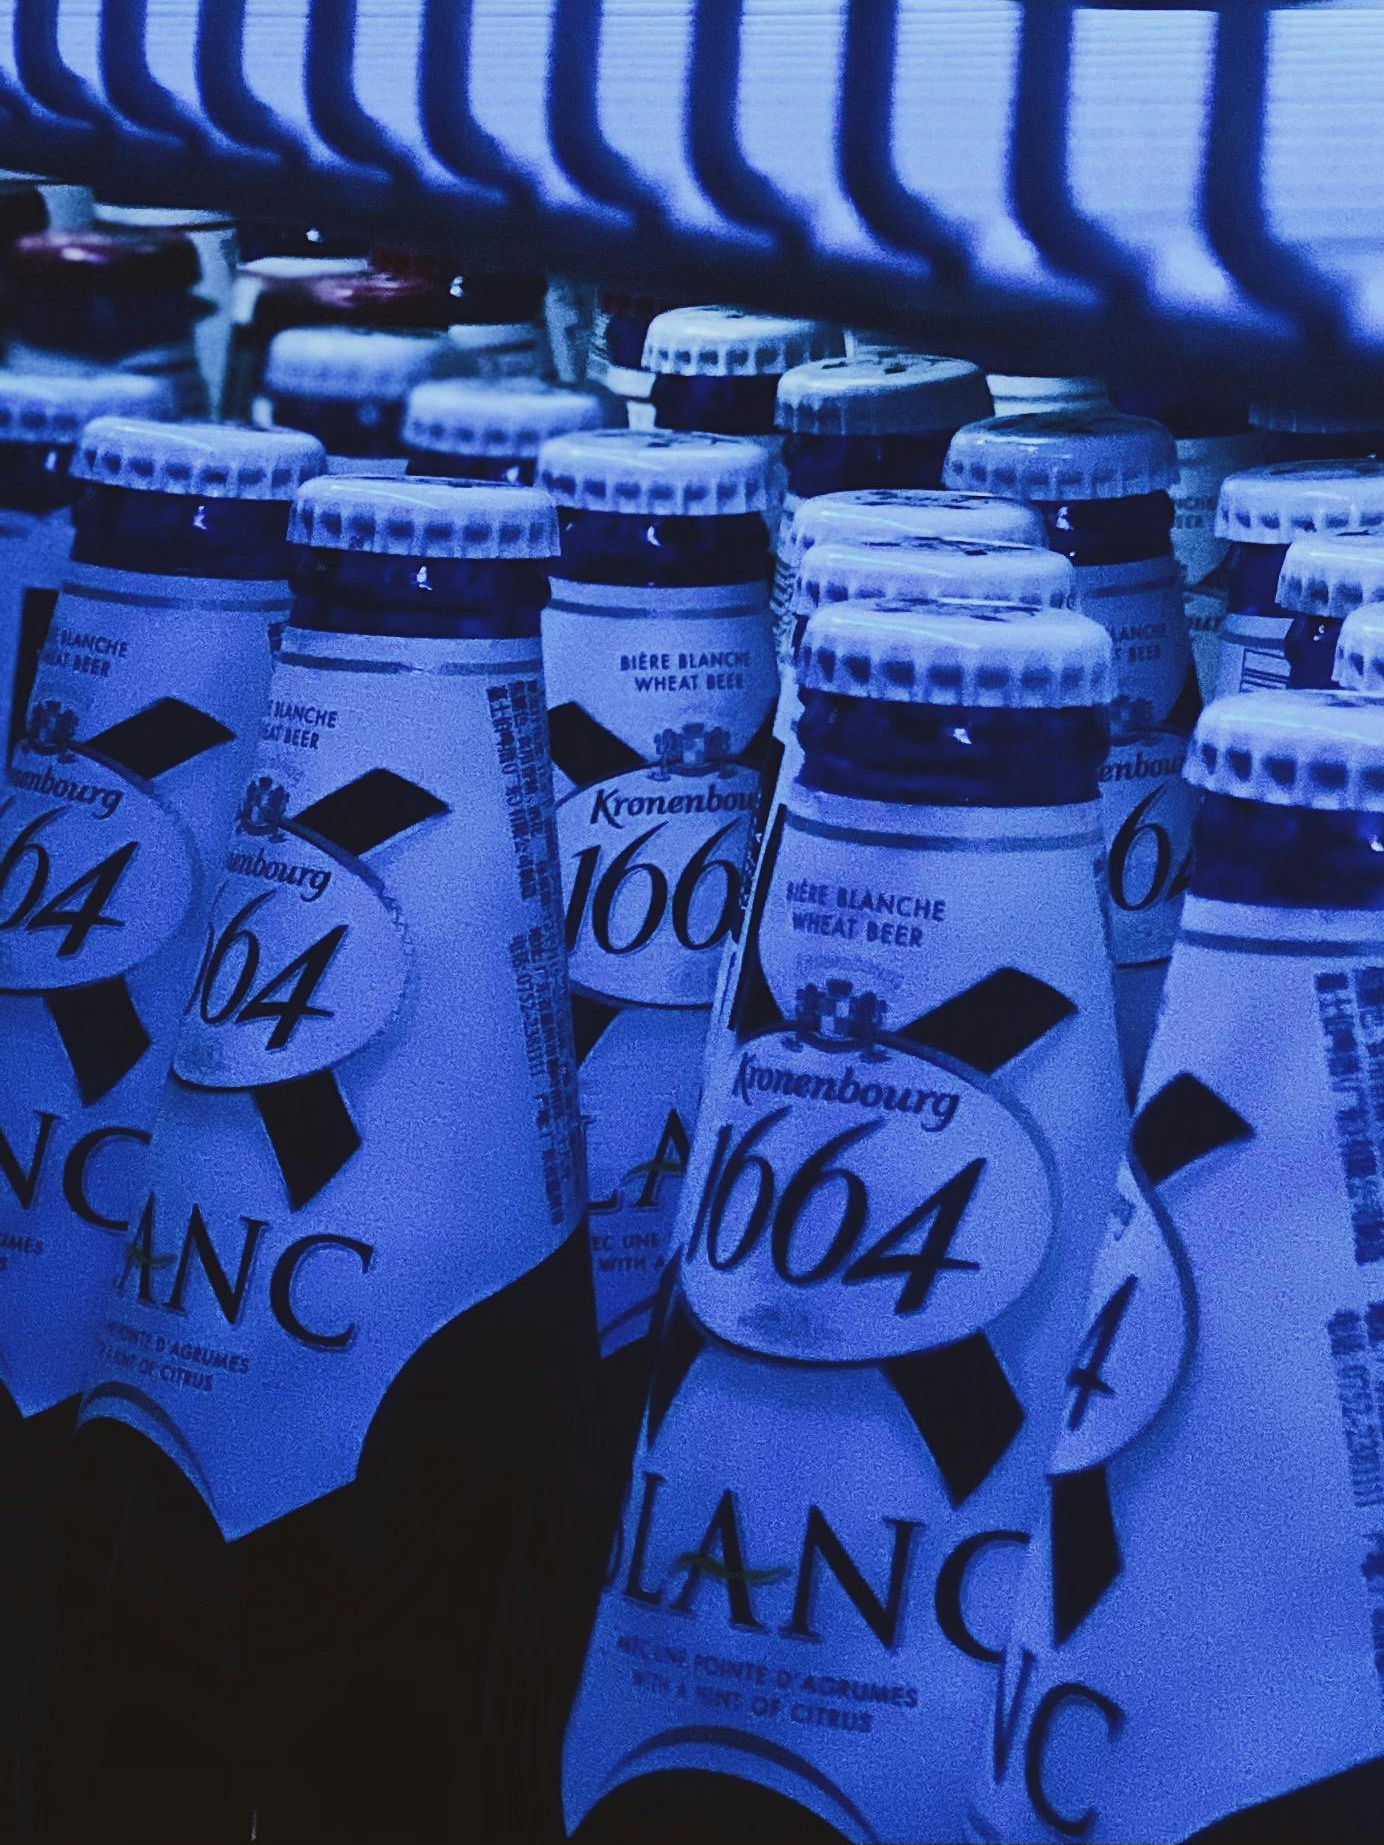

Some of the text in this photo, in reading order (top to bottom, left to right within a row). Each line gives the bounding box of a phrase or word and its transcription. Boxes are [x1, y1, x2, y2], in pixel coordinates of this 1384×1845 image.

[619, 652, 670, 672] BIÈRE
[634, 673, 744, 693] WHEAT BEER
[836, 886, 946, 923] BLANCHE
[791, 912, 924, 950] WHEAT BEER
[606, 1470, 1033, 1665] LANC
